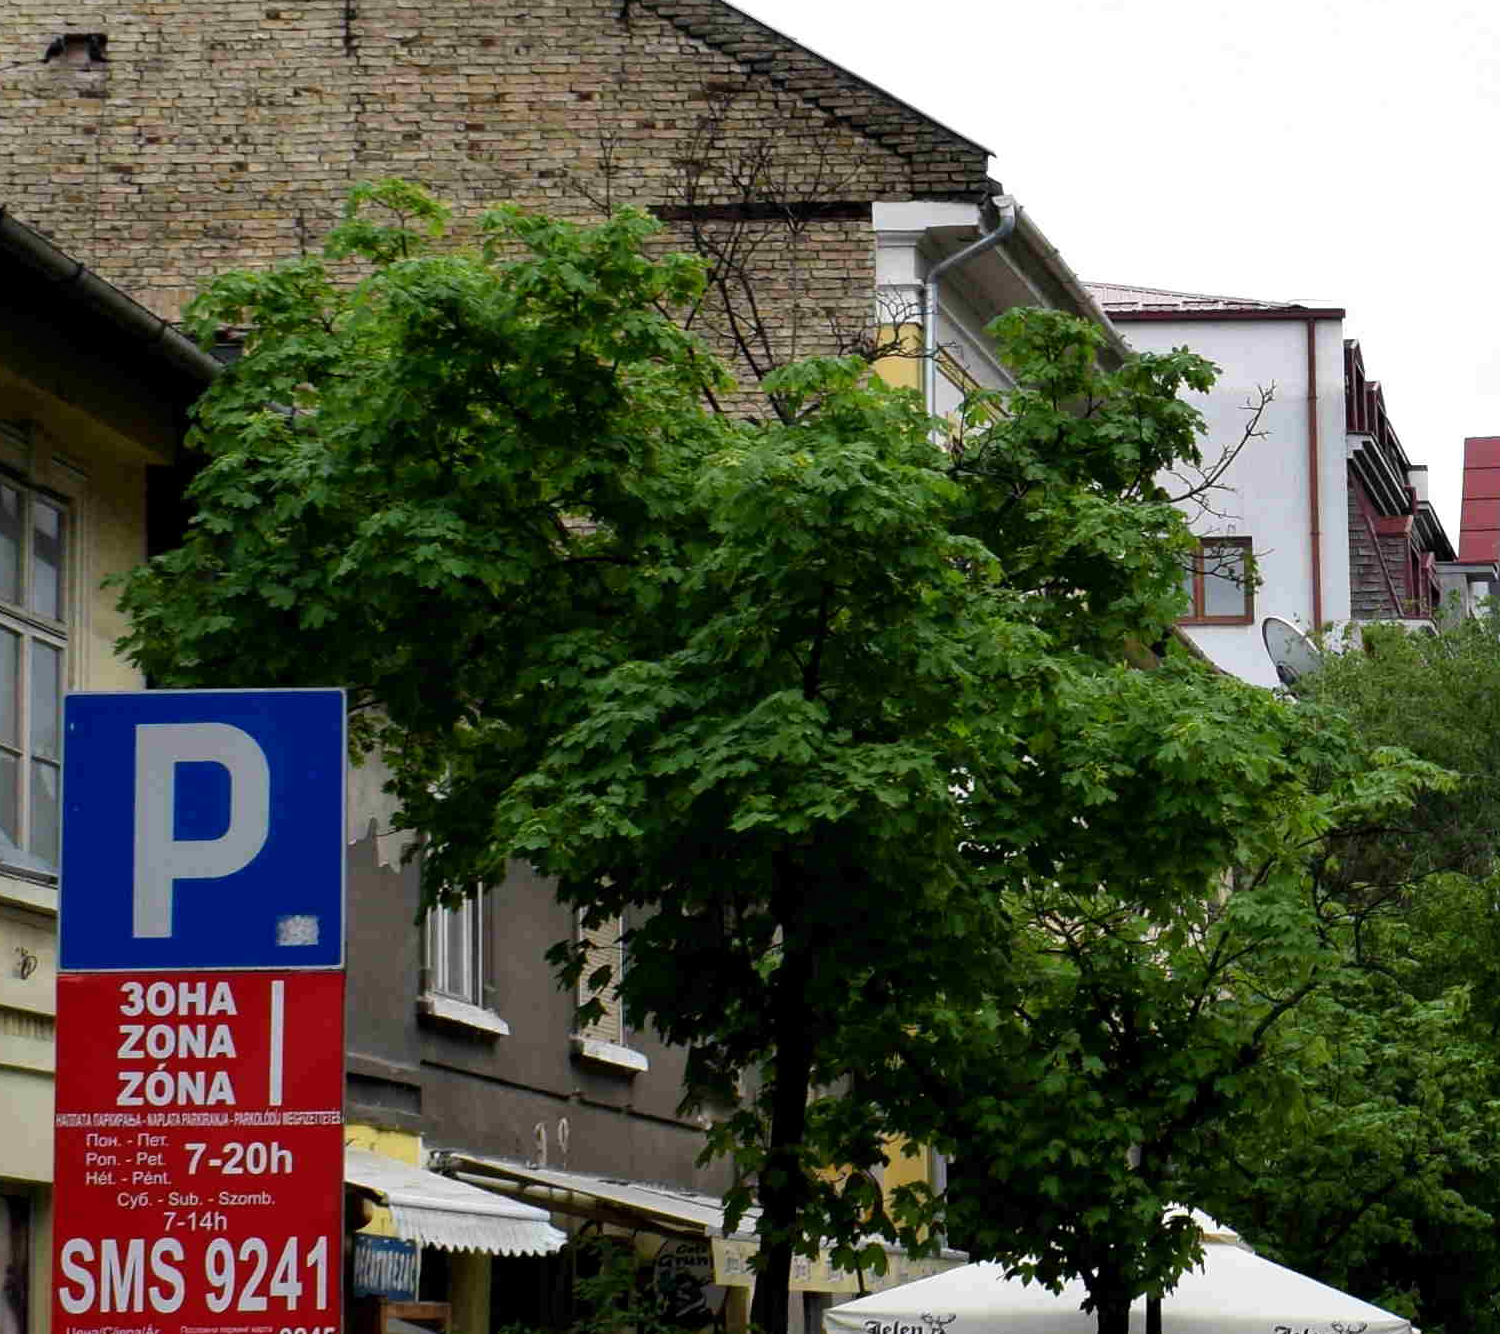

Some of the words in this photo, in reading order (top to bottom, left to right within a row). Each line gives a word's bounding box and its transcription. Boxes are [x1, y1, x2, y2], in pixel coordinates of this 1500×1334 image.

[133, 722, 270, 938] P
[119, 982, 238, 1017] ЗОНА
[116, 1024, 237, 1059] ZONA
[116, 1063, 237, 1106] ZÓNA
[86, 1152, 122, 1166] Pon.
[184, 1142, 293, 1176] 7-20h
[117, 1191, 152, 1209] Суб.
[168, 1192, 203, 1206] Sub.
[218, 1191, 276, 1206] Szomb.
[163, 1211, 228, 1232] 7-14h
[59, 1237, 186, 1314] SMS
[204, 1236, 329, 1313] 9241
